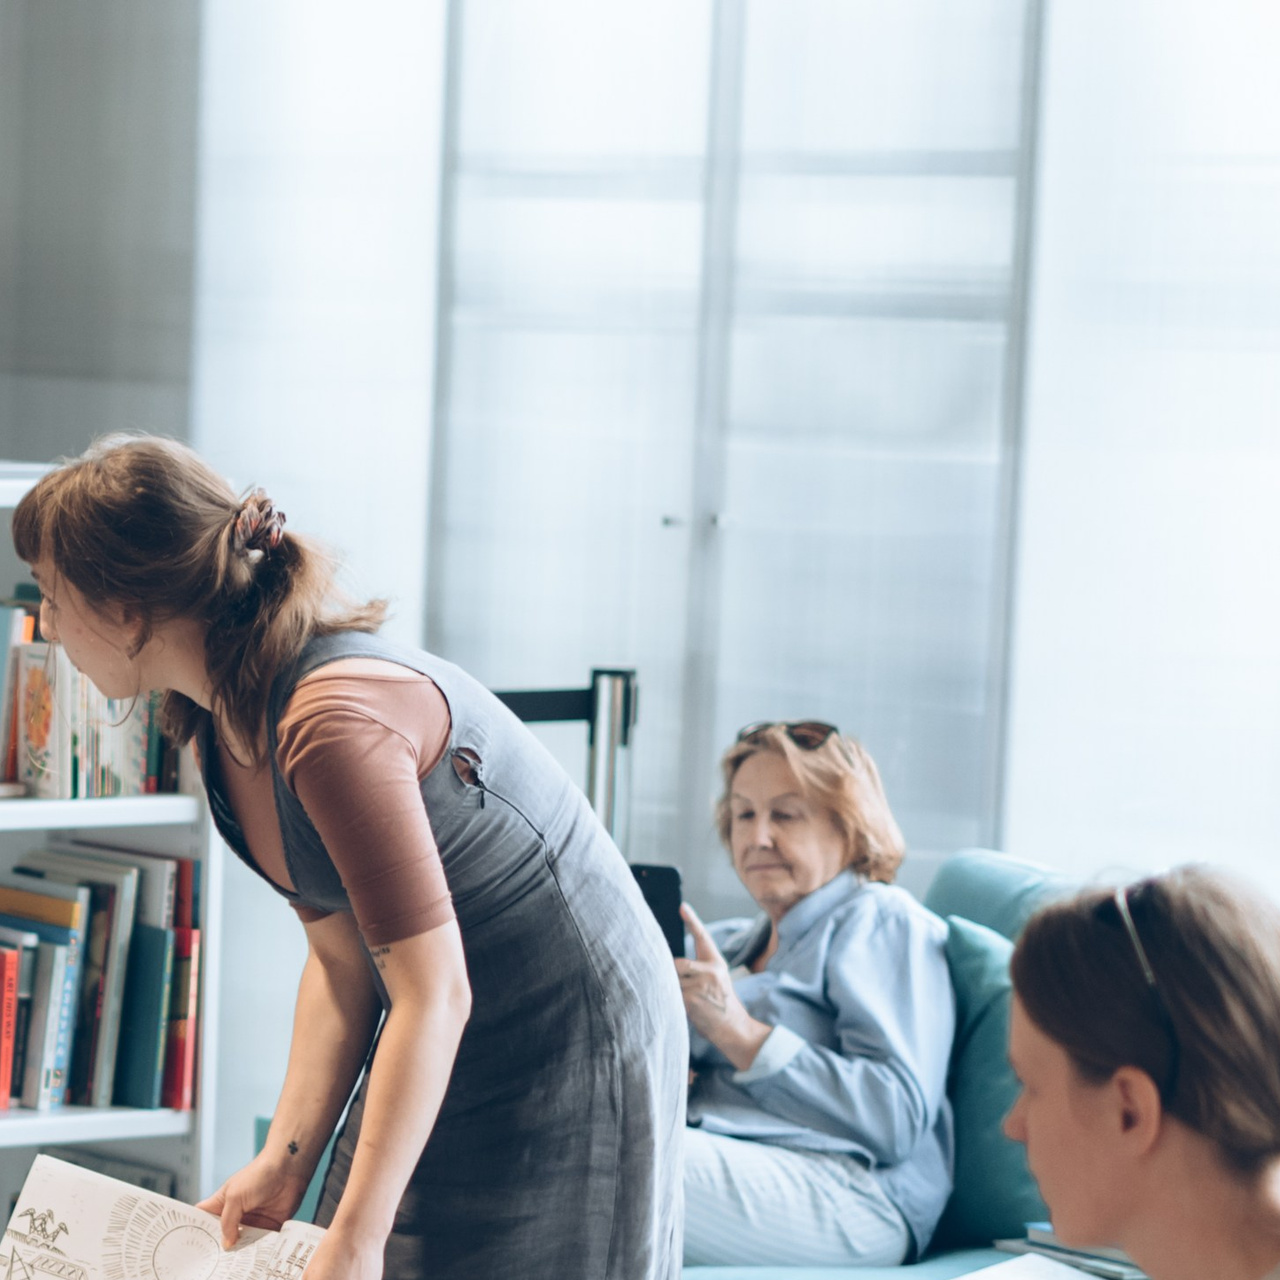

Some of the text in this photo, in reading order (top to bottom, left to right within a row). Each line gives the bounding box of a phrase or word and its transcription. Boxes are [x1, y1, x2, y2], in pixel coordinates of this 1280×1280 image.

[6, 976, 14, 993] ART
[5, 997, 13, 1018] THIS
[4, 1020, 12, 1041] WAY
